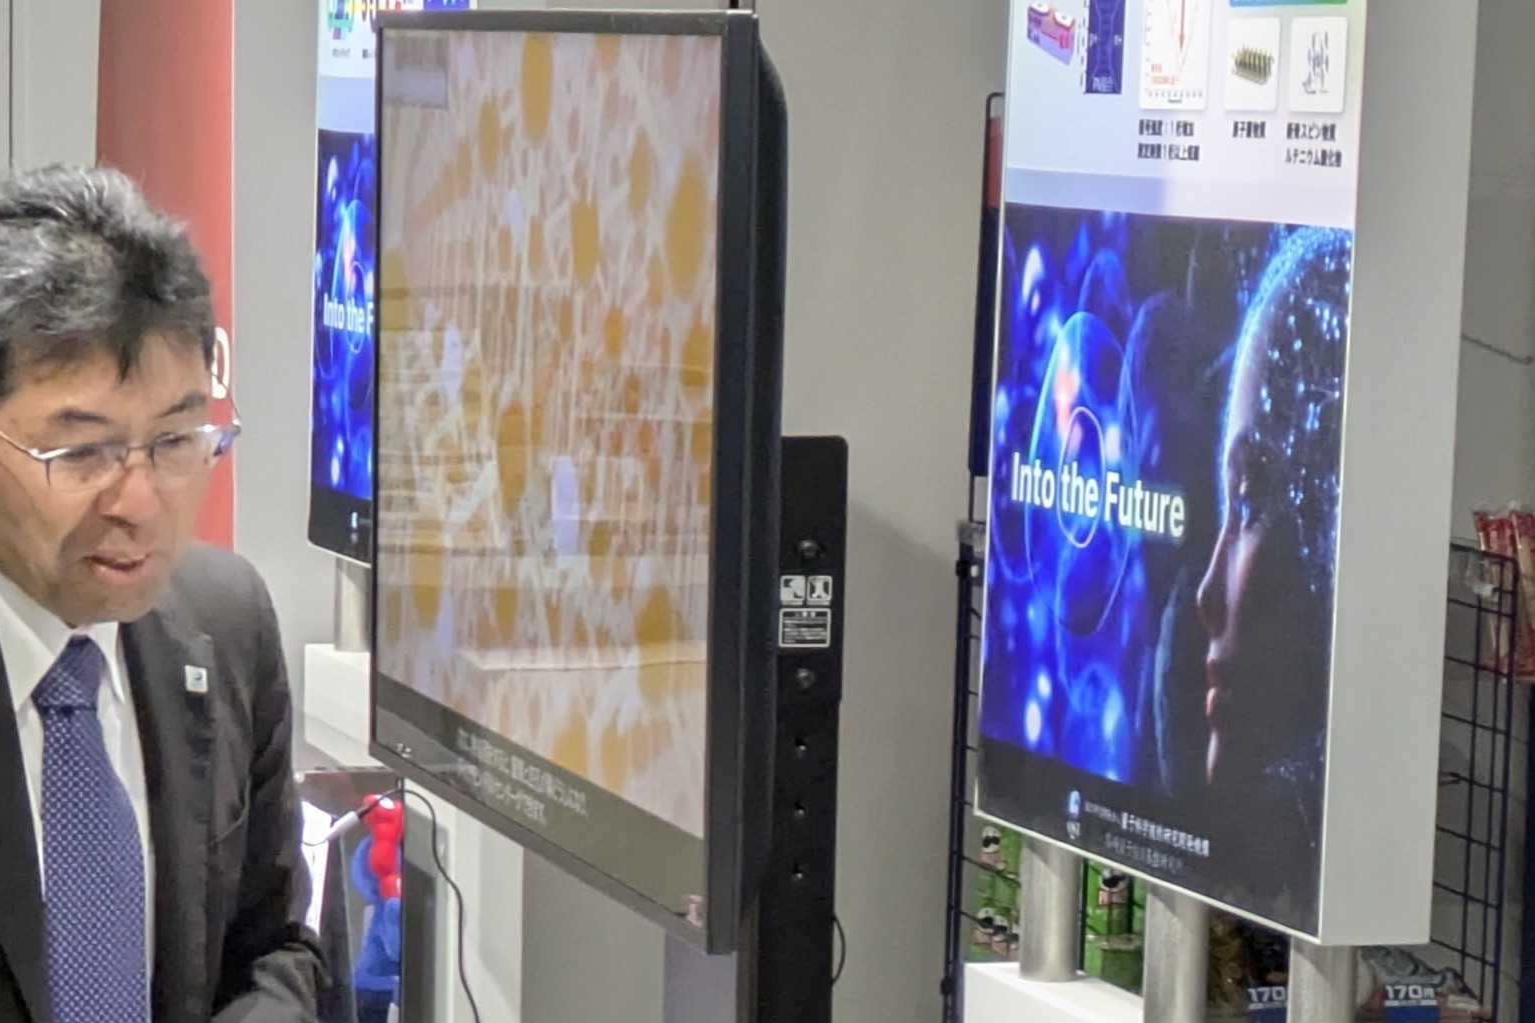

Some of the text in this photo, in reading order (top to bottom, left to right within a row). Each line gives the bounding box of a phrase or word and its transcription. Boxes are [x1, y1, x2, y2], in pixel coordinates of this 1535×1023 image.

[323, 292, 374, 335] Into the F
[1011, 452, 1185, 538] Into the Future
